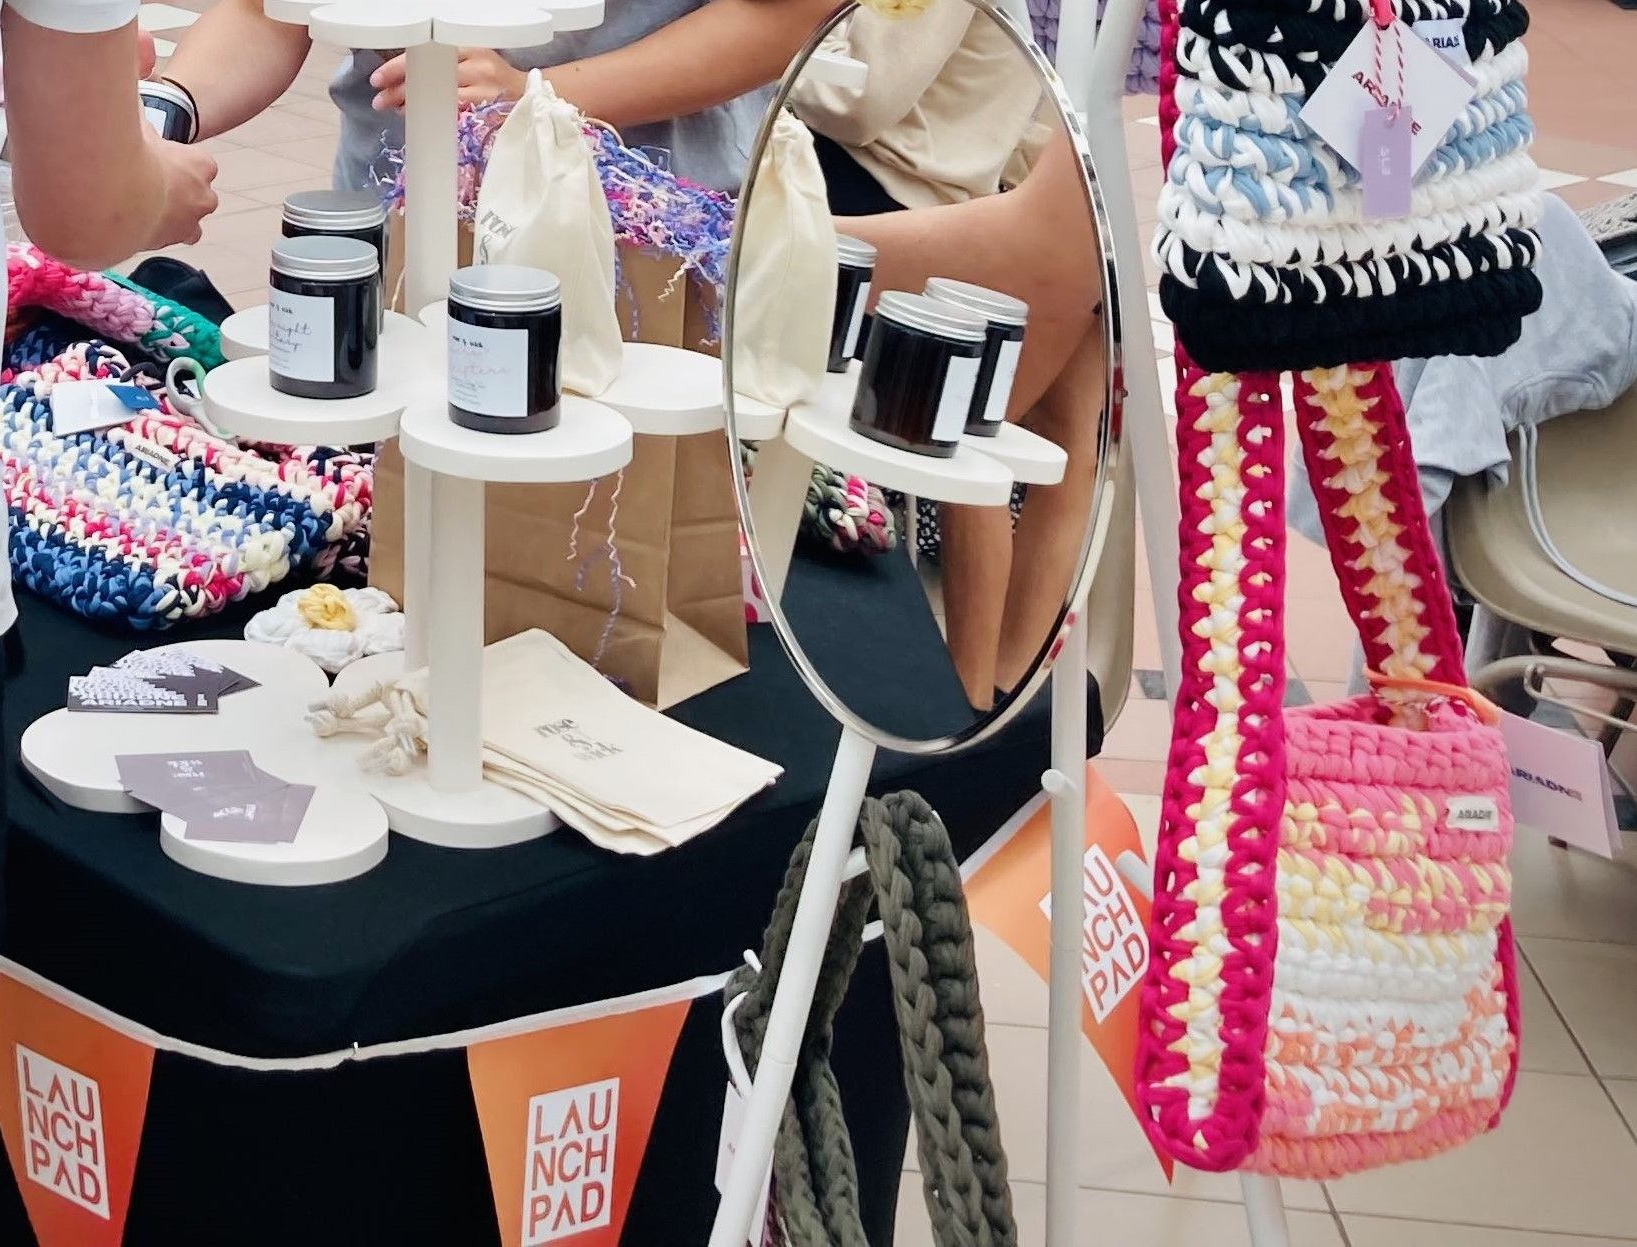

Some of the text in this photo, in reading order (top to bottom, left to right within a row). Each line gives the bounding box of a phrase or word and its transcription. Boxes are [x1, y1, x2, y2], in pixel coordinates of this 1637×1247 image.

[1089, 933, 1146, 1011] PAD
[23, 1054, 95, 1122] LAU
[534, 1088, 612, 1145] LAU
[26, 1096, 99, 1165] NCH
[531, 1133, 610, 1191] NCH
[30, 1138, 102, 1205] PAD
[529, 1180, 605, 1238] PAD
